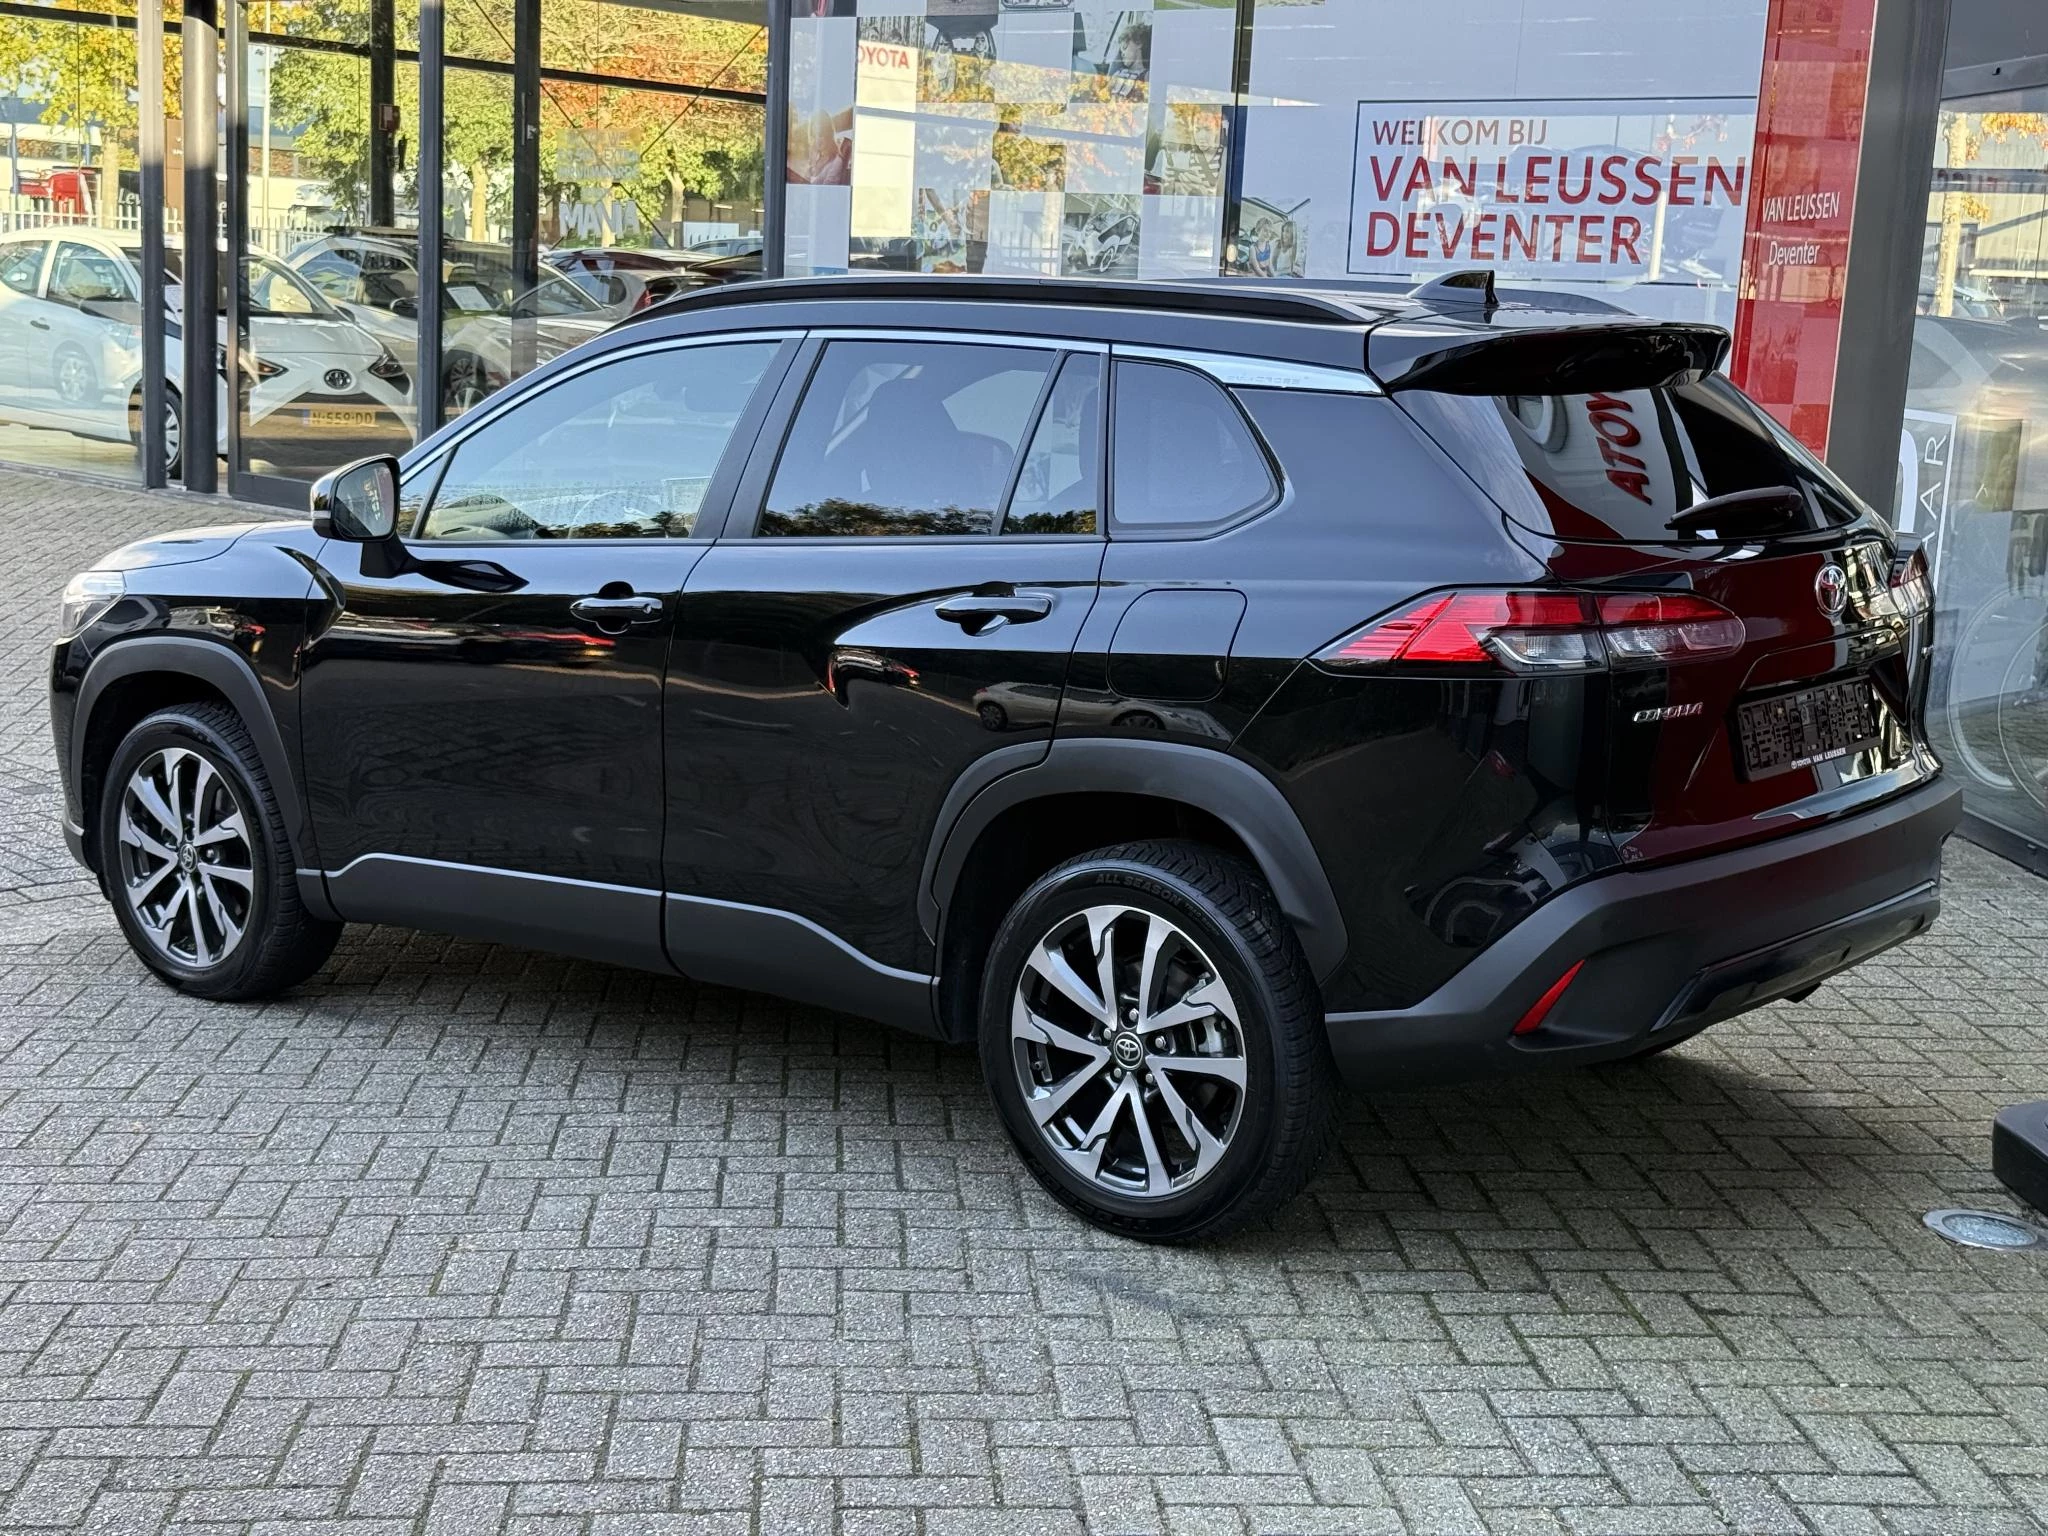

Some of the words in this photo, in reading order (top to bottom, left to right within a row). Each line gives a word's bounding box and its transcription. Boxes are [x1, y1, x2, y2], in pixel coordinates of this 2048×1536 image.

[1373, 119, 1500, 146] WELKOM
[1508, 119, 1548, 146] BIJ
[1369, 155, 1478, 202] VAN
[1495, 155, 1746, 206] LEUSSEN
[1762, 196, 1786, 222] VAN
[1786, 191, 1840, 222] LEUSSEN
[1366, 211, 1642, 265] DEVENTER
[1768, 240, 1821, 266] Deventer
[1096, 873, 1120, 884] ALL
[1123, 875, 1184, 905] SEASON
